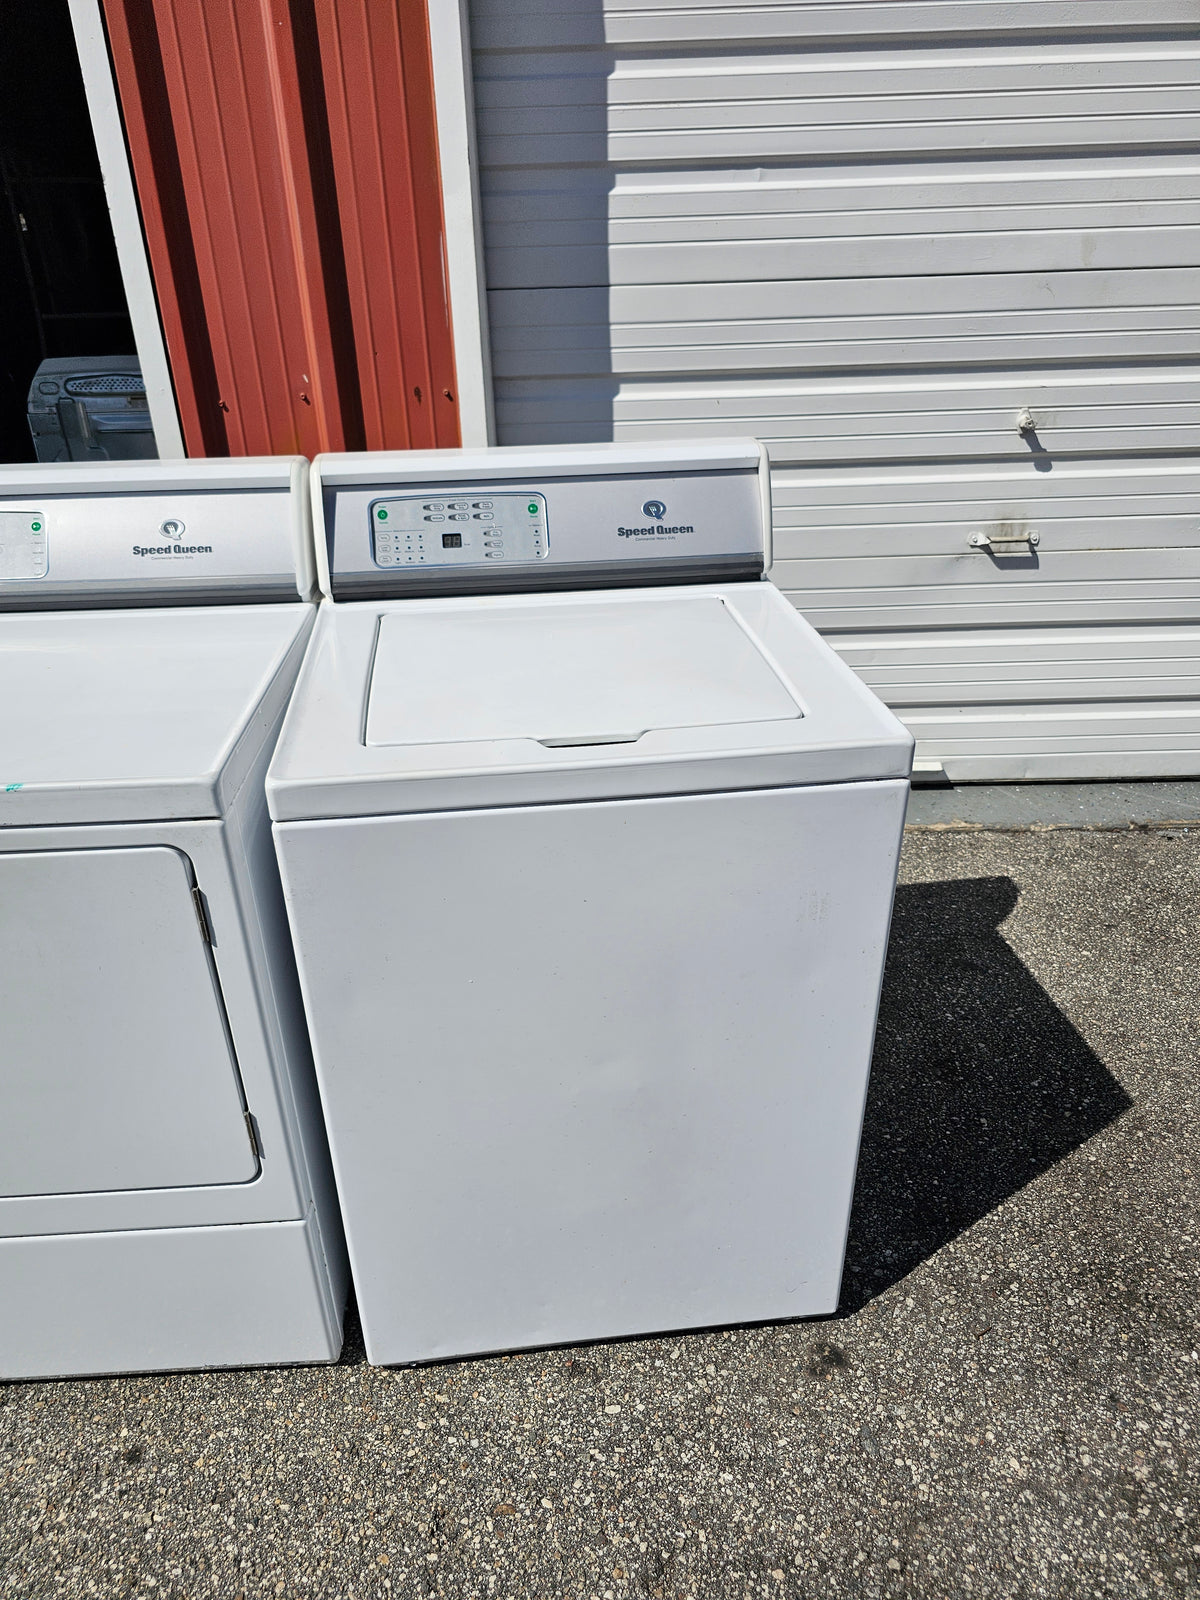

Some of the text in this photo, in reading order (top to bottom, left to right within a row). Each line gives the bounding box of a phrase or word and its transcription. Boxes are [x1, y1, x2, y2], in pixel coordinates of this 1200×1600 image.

[617, 525, 694, 538] Speed Queen
[132, 544, 213, 557] Speed Queen
